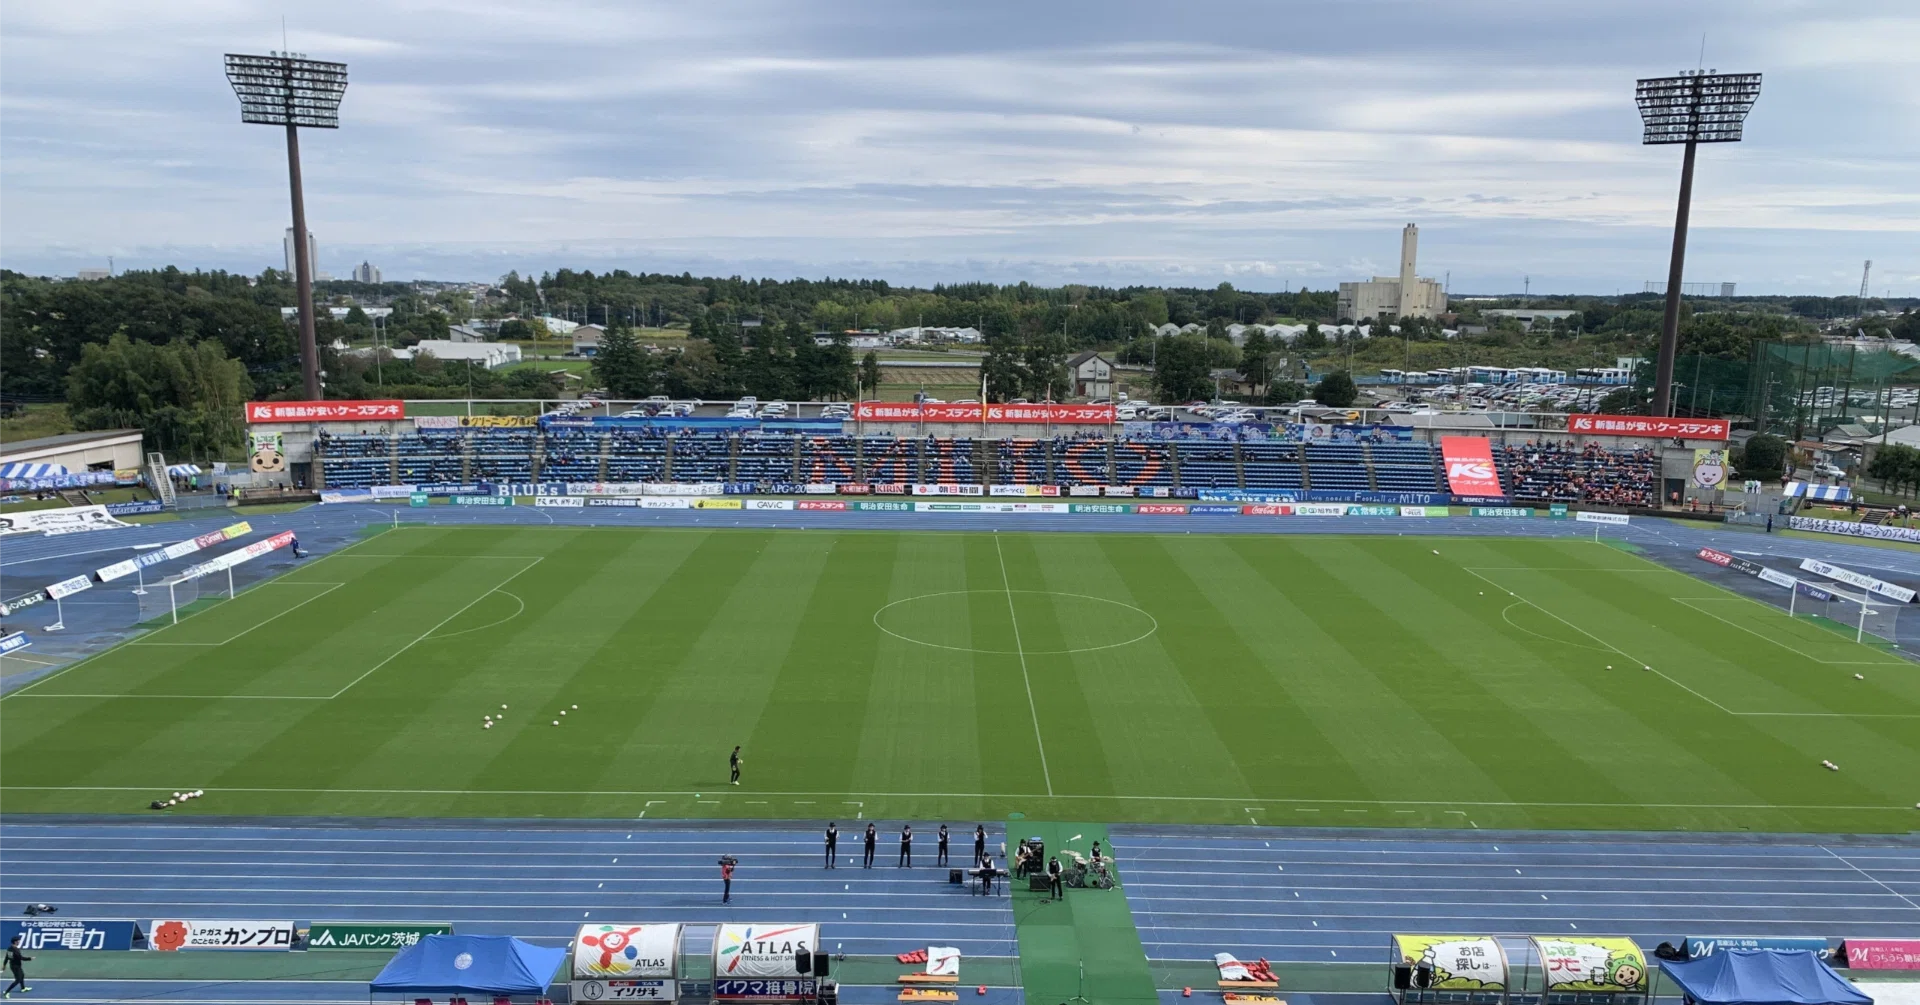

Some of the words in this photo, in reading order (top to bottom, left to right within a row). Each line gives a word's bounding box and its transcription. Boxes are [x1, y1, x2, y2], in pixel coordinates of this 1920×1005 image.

[275, 405, 399, 418] 新製品が安いケーズデンキ
[875, 408, 982, 419] 新製品が安いケーズデンキ
[1005, 409, 1112, 420] 新製品が安いケーズデンキ
[1595, 420, 1723, 435] 新製品が安いケーズデンキ
[877, 485, 903, 493] KIRIN
[938, 486, 979, 494] 朝日新聞
[993, 486, 1025, 494] スポーツくじ
[456, 496, 506, 505] 明治安田生命
[1400, 494, 1430, 504] MITO
[860, 503, 908, 511] 明治安田生命
[1075, 505, 1124, 513] 明治安田生命
[1252, 506, 1276, 514] Coca-Cola
[1478, 508, 1527, 517] 明治安田生命
[245, 542, 268, 555] ISUZU
[192, 928, 222, 937] LPガス
[221, 926, 291, 946] カンプロ
[17, 928, 106, 950] 水戸電力
[190, 937, 221, 945] のことなら
[338, 931, 421, 947] JAバンク茨城
[741, 940, 807, 955] ATLAS
[1458, 946, 1485, 957] お店
[635, 958, 665, 968] ATLAS
[613, 987, 660, 997] イソザキ
